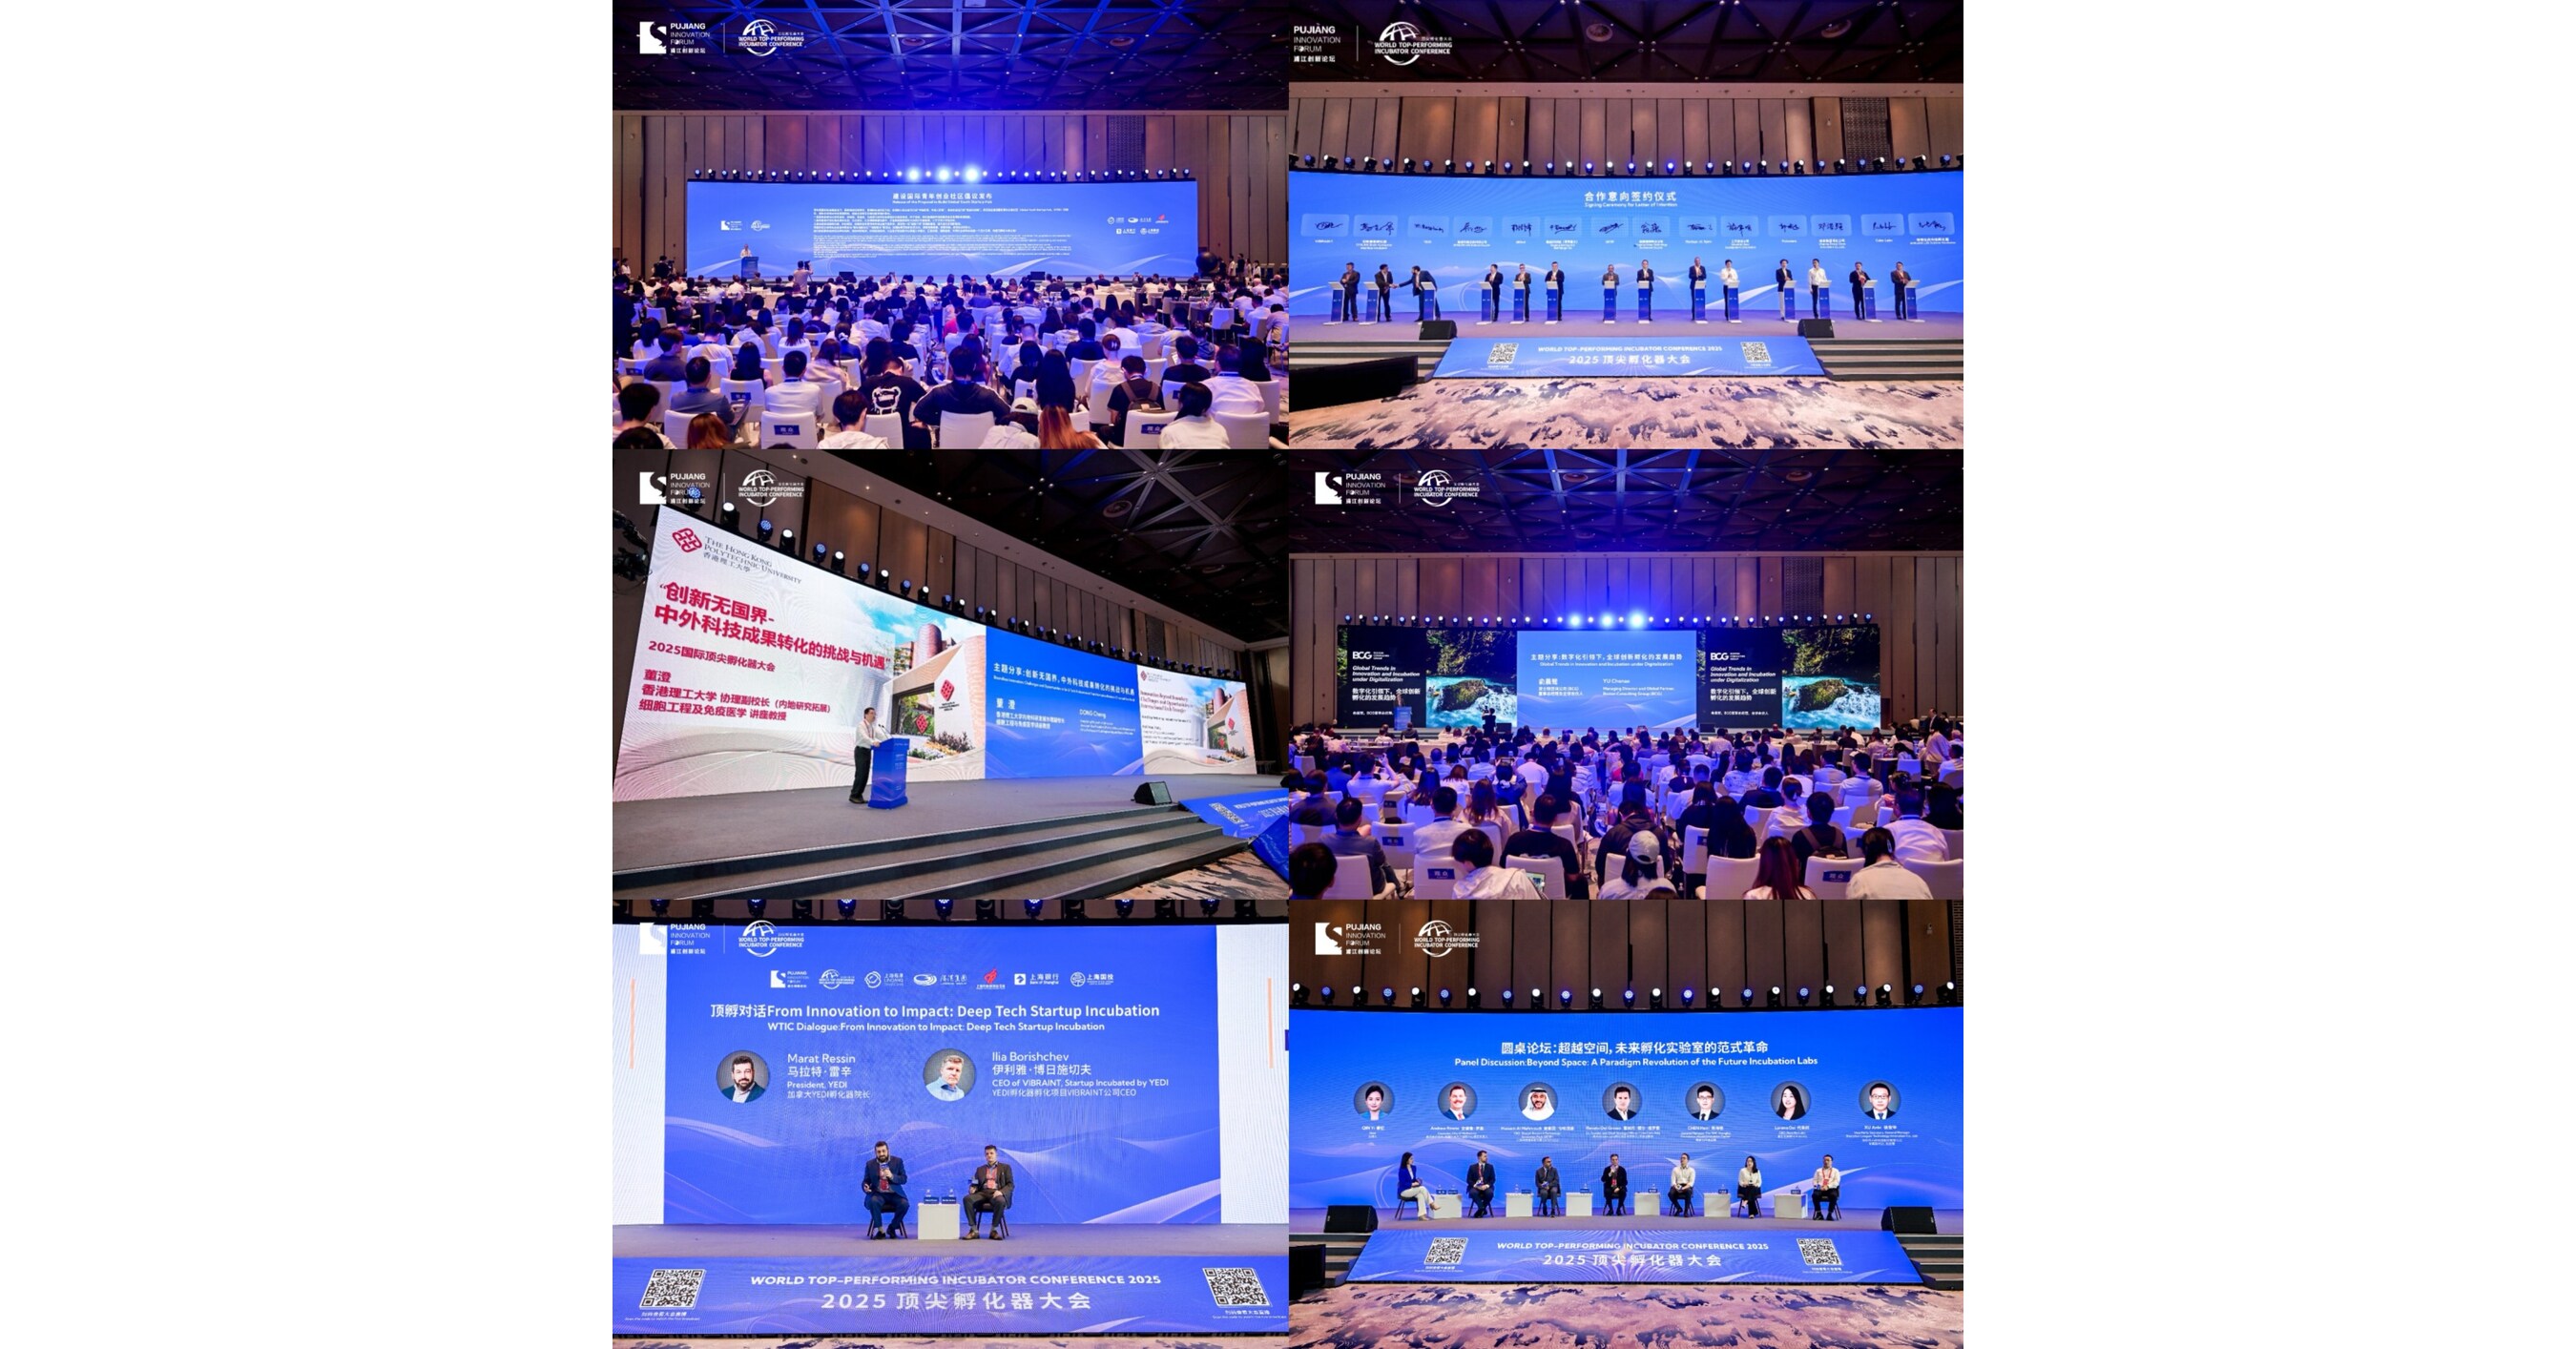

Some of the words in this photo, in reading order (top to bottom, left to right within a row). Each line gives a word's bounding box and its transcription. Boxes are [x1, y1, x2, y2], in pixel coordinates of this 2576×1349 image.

[1585, 191, 1676, 201] 合作意向签约仪式
[1568, 355, 1599, 364] 2025
[1603, 355, 1691, 364] 顶尖孵化器大会
[705, 535, 724, 550] THE
[725, 543, 750, 560] HONG
[750, 553, 773, 568] KONG
[702, 551, 751, 572] 香港理工大學
[704, 544, 761, 571] POLYTECHNIC
[761, 563, 802, 585] UNIVERSITY
[648, 641, 776, 673] 2025国际顶尖孵化器大会
[1353, 651, 1372, 660] BCG
[643, 669, 672, 683] 董澄
[641, 683, 717, 701] 香港理工大学
[638, 698, 747, 718] 细胞工程及免疫医学
[750, 708, 787, 721] 讲座教授
[711, 1004, 802, 1018] 顶孵对话From
[806, 1005, 880, 1017] Innovation
[883, 1006, 898, 1017] to
[902, 1006, 953, 1020] Impact:
[958, 1006, 992, 1020] Deep
[995, 1005, 1027, 1017] Tech
[1030, 1006, 1082, 1019] Startup
[1086, 1004, 1159, 1017] Incubation
[797, 1023, 864, 1033] Dialogue:From
[866, 1023, 916, 1031] Innovation
[930, 1023, 964, 1033] Impact:
[966, 1023, 992, 1032] Deep
[1018, 1022, 1053, 1032] Startup
[788, 1053, 820, 1064] Marat
[822, 1053, 856, 1064] Ressin
[992, 1051, 1008, 1061] Ilia
[1009, 1051, 1069, 1061] Borishchev
[1454, 1058, 1479, 1067] Panel
[1481, 1058, 1560, 1068] Discussion:Beyond
[1561, 1058, 1589, 1068] Space:
[1600, 1058, 1641, 1069] Paradigm
[1691, 1057, 1700, 1066] of
[788, 1066, 851, 1077] 马拉特·雷辛
[992, 1064, 1091, 1075] 伊利雅·博日施切夫
[1022, 1079, 1063, 1088] VIBRAINT,
[1065, 1079, 1094, 1088] Startup
[1137, 1079, 1147, 1088] by
[1543, 1255, 1586, 1266] 2025
[1592, 1255, 1721, 1266] 顶尖孵化器大会
[751, 1276, 804, 1285] WORLD
[808, 1276, 937, 1285] TOP-PERFORMING
[942, 1276, 1027, 1285] INCUBATOR
[1029, 1276, 1125, 1285] CONFERENCE
[1128, 1276, 1161, 1285] 2025
[821, 1293, 886, 1310] 2025
[896, 1293, 1091, 1310] 顶尖孵化器大会
